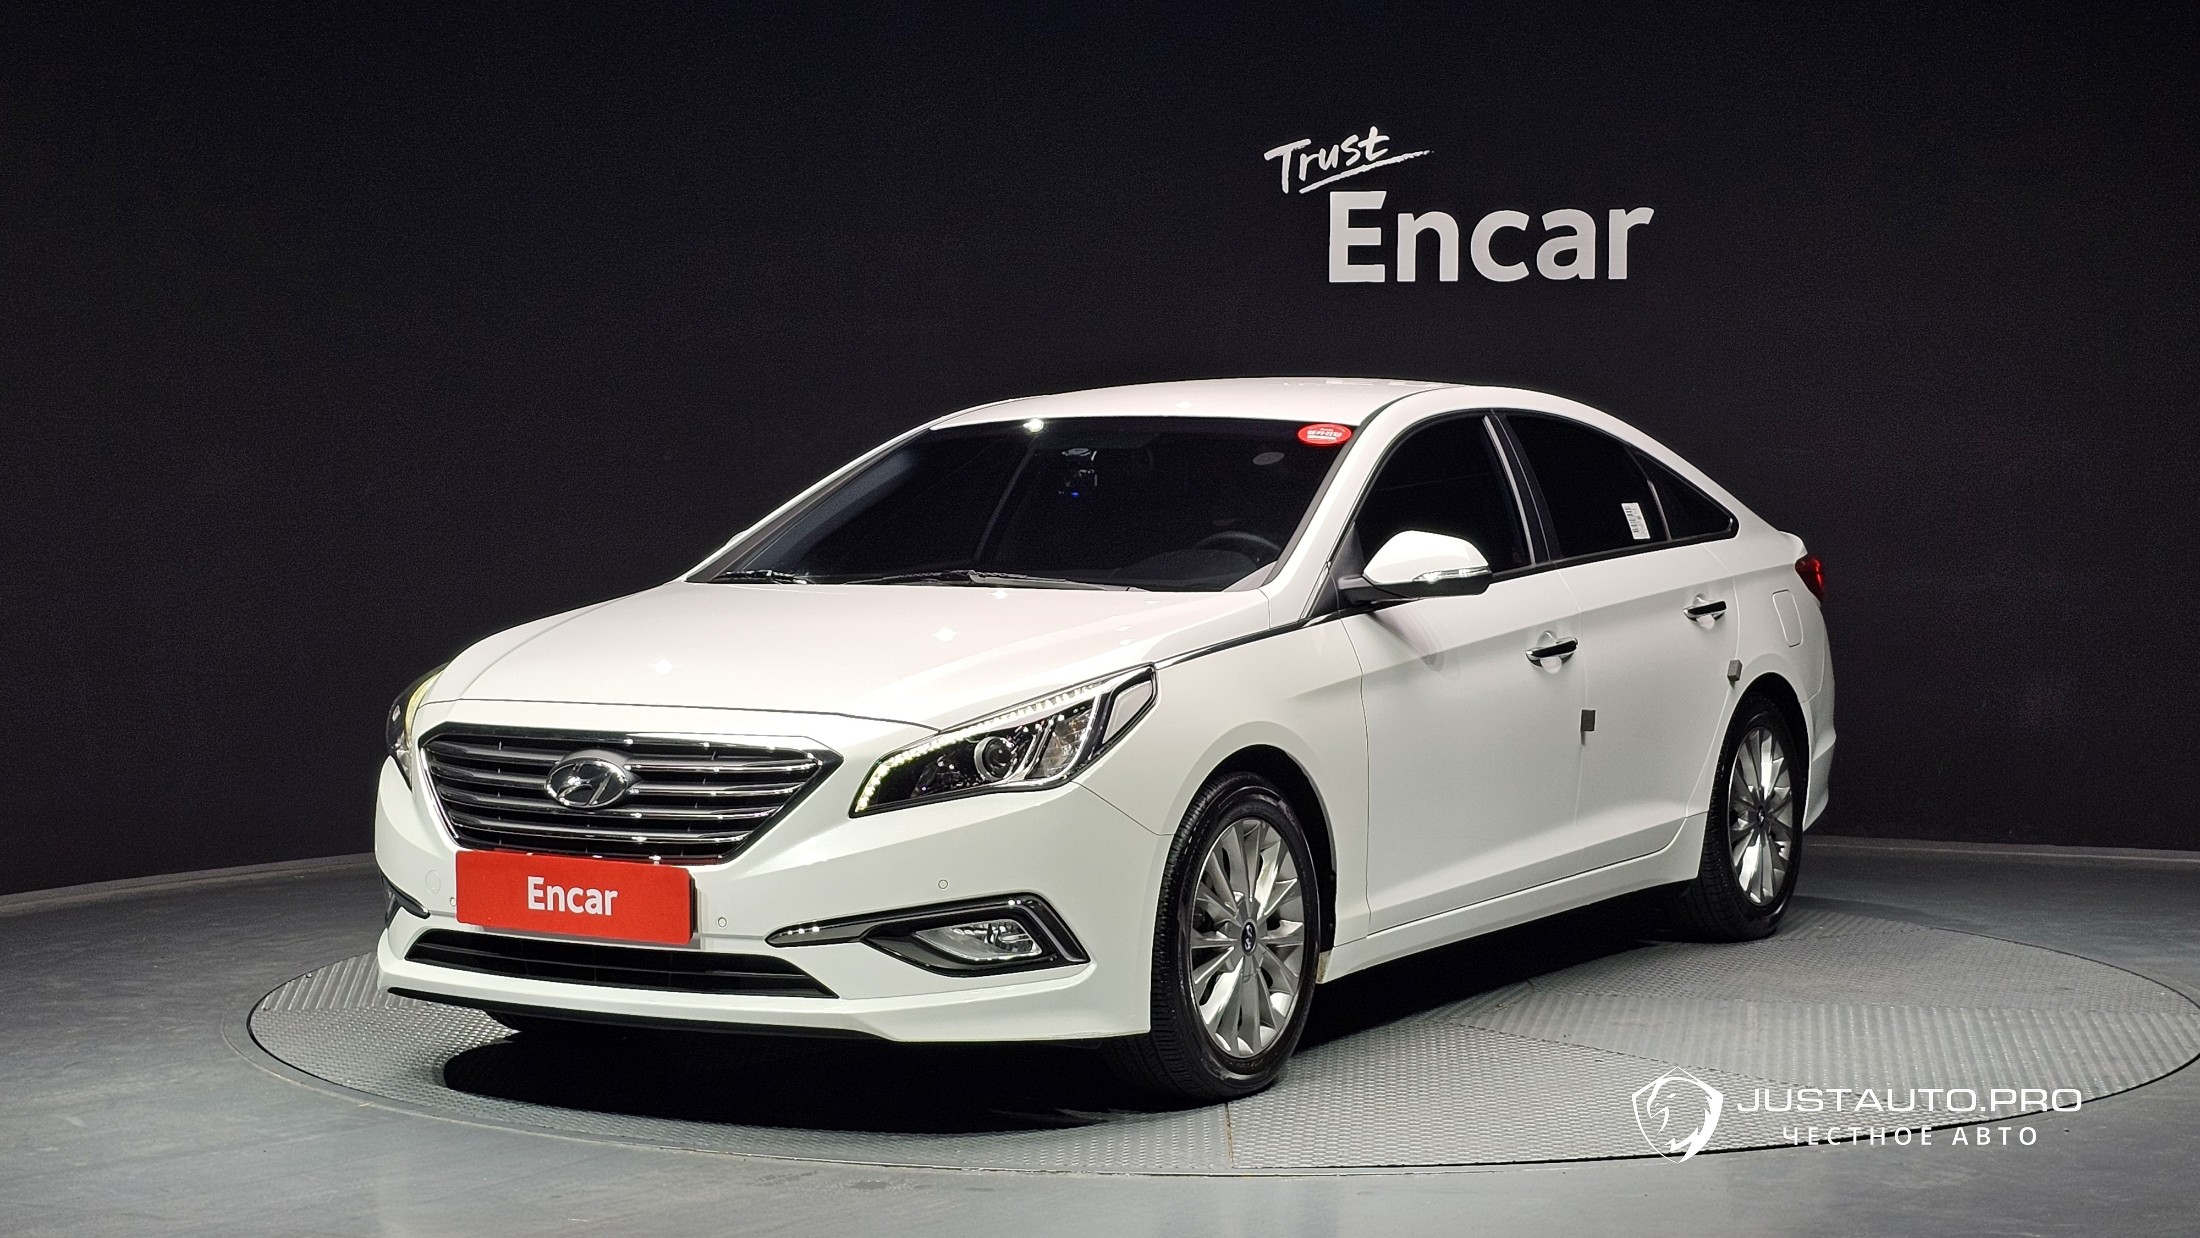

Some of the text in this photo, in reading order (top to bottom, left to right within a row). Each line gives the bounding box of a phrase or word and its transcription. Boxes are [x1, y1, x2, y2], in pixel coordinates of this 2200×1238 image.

[1264, 126, 1390, 194] Trust
[1329, 191, 1655, 283] Encar
[527, 876, 619, 916] Encar
